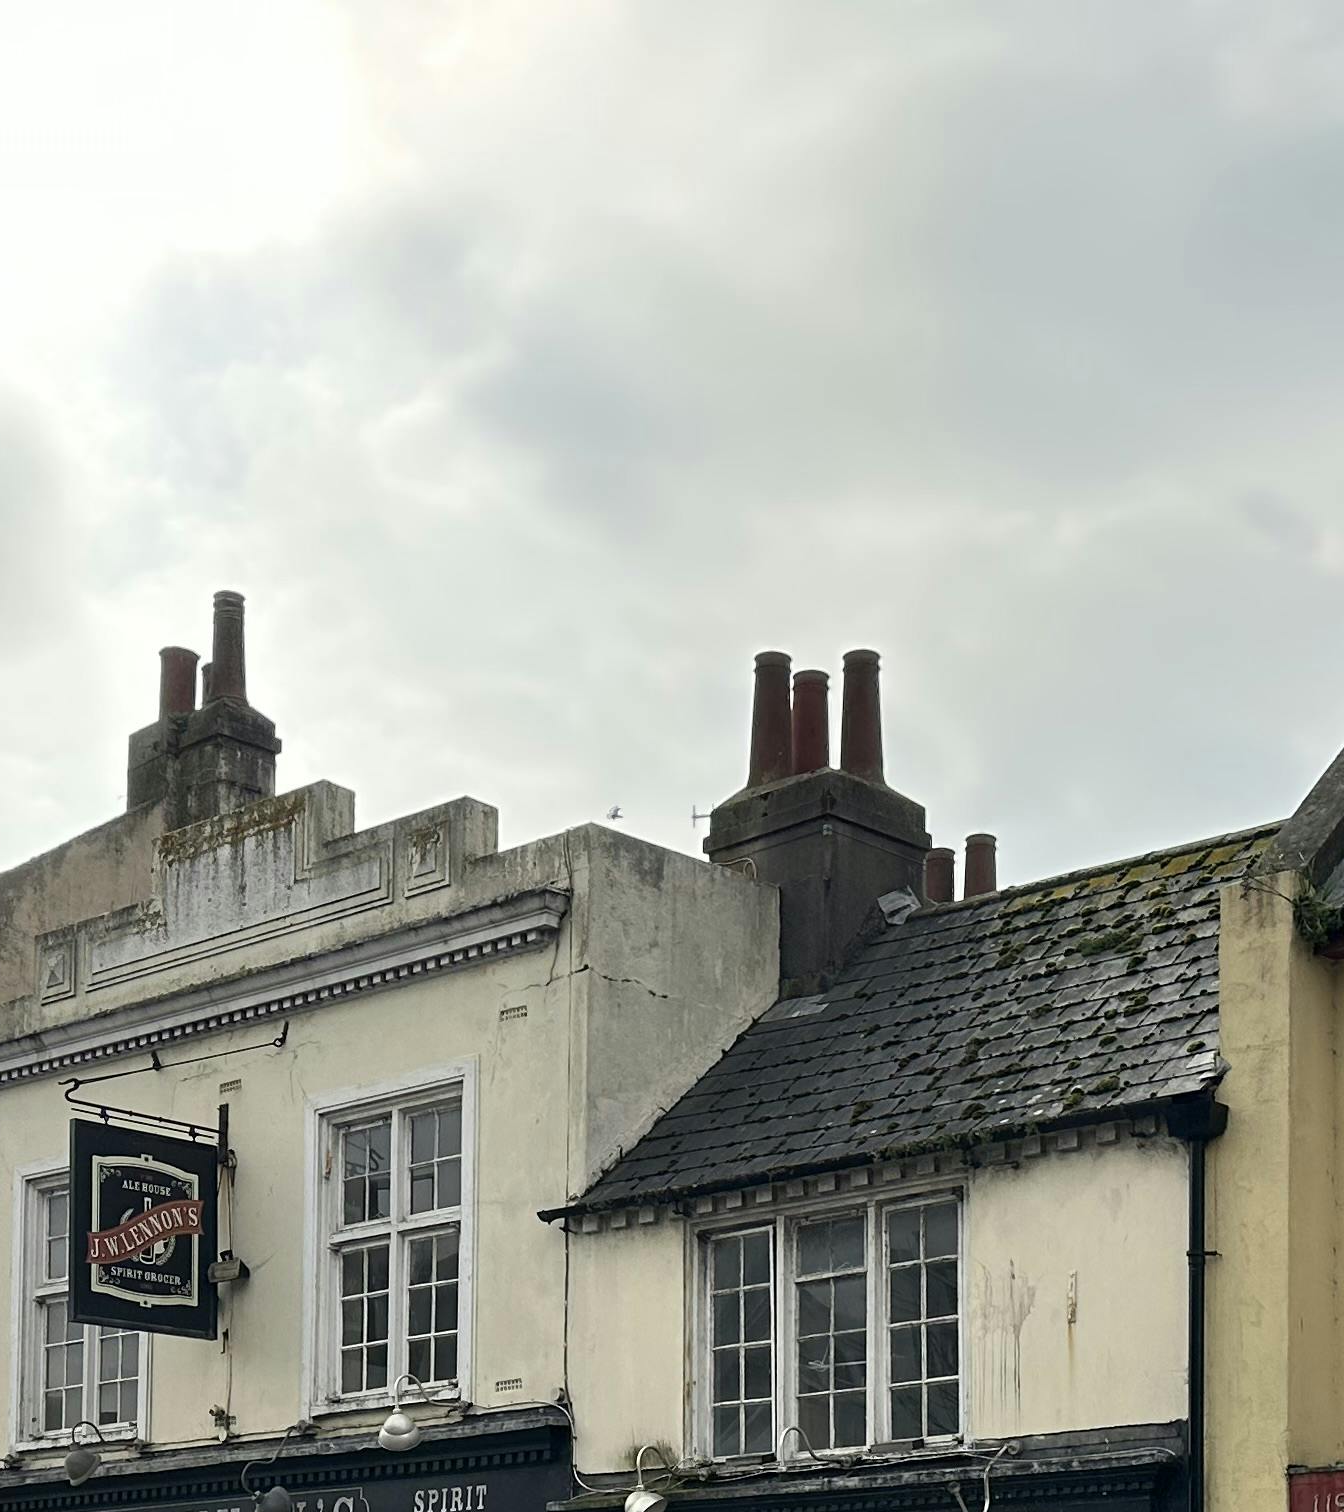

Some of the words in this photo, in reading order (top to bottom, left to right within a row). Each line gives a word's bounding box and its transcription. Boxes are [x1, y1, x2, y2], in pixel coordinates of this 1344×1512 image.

[122, 1180, 140, 1190] ALE
[142, 1183, 171, 1196] HOUSE
[111, 1266, 142, 1280] SPIRIT
[145, 1272, 181, 1285] GROCER
